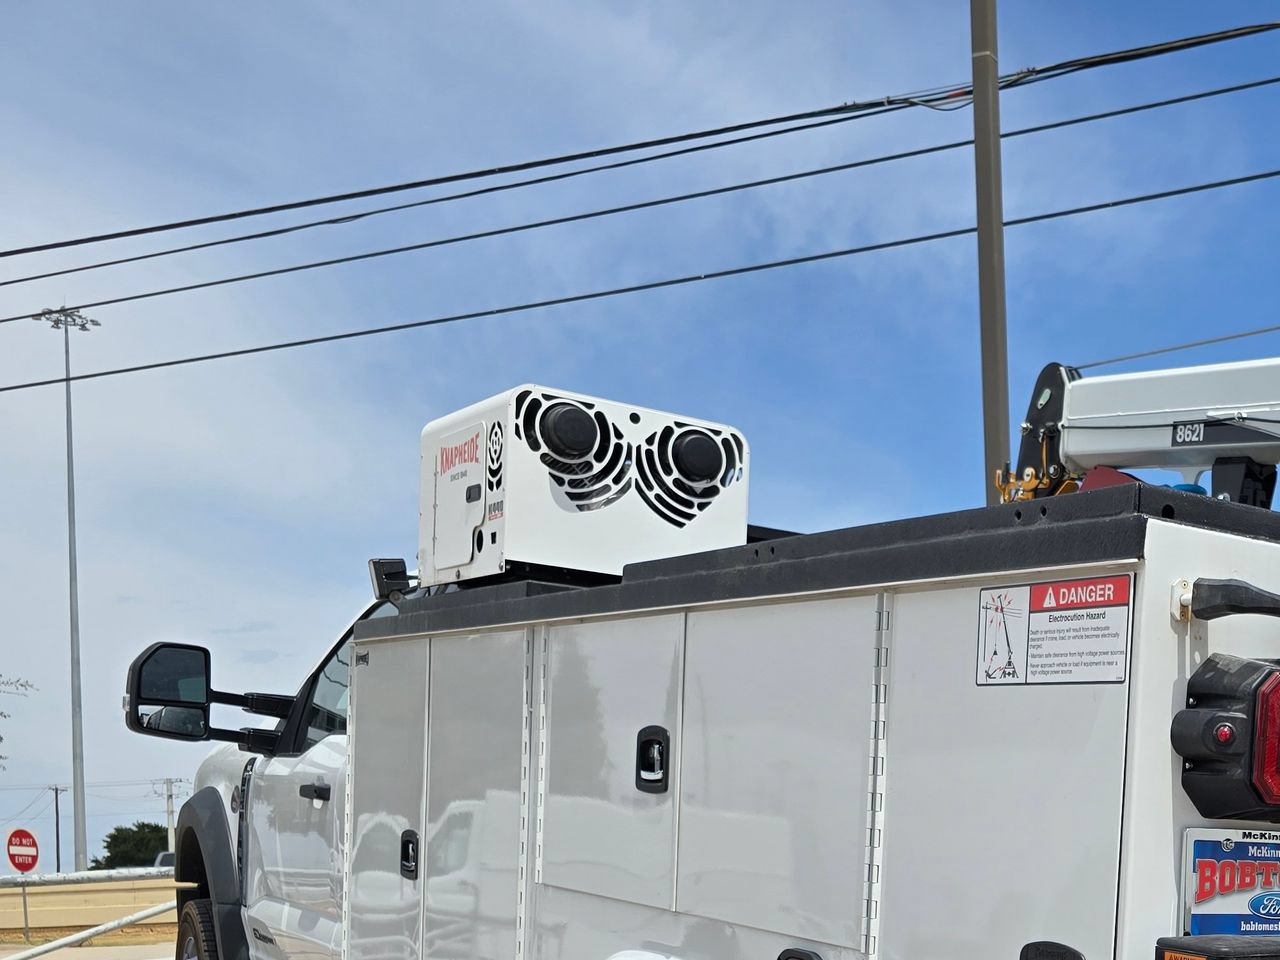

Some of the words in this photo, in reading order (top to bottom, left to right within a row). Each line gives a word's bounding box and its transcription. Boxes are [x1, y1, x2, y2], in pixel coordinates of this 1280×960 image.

[1176, 423, 1205, 443] 8621
[440, 431, 481, 476] KNAPHEIDE
[1060, 584, 1114, 604] DANGER
[1048, 613, 1085, 623] Electrocution
[1086, 611, 1106, 620] Hazard
[11, 837, 20, 846] DO
[22, 838, 33, 846] NOT
[15, 856, 33, 864] ENTER
